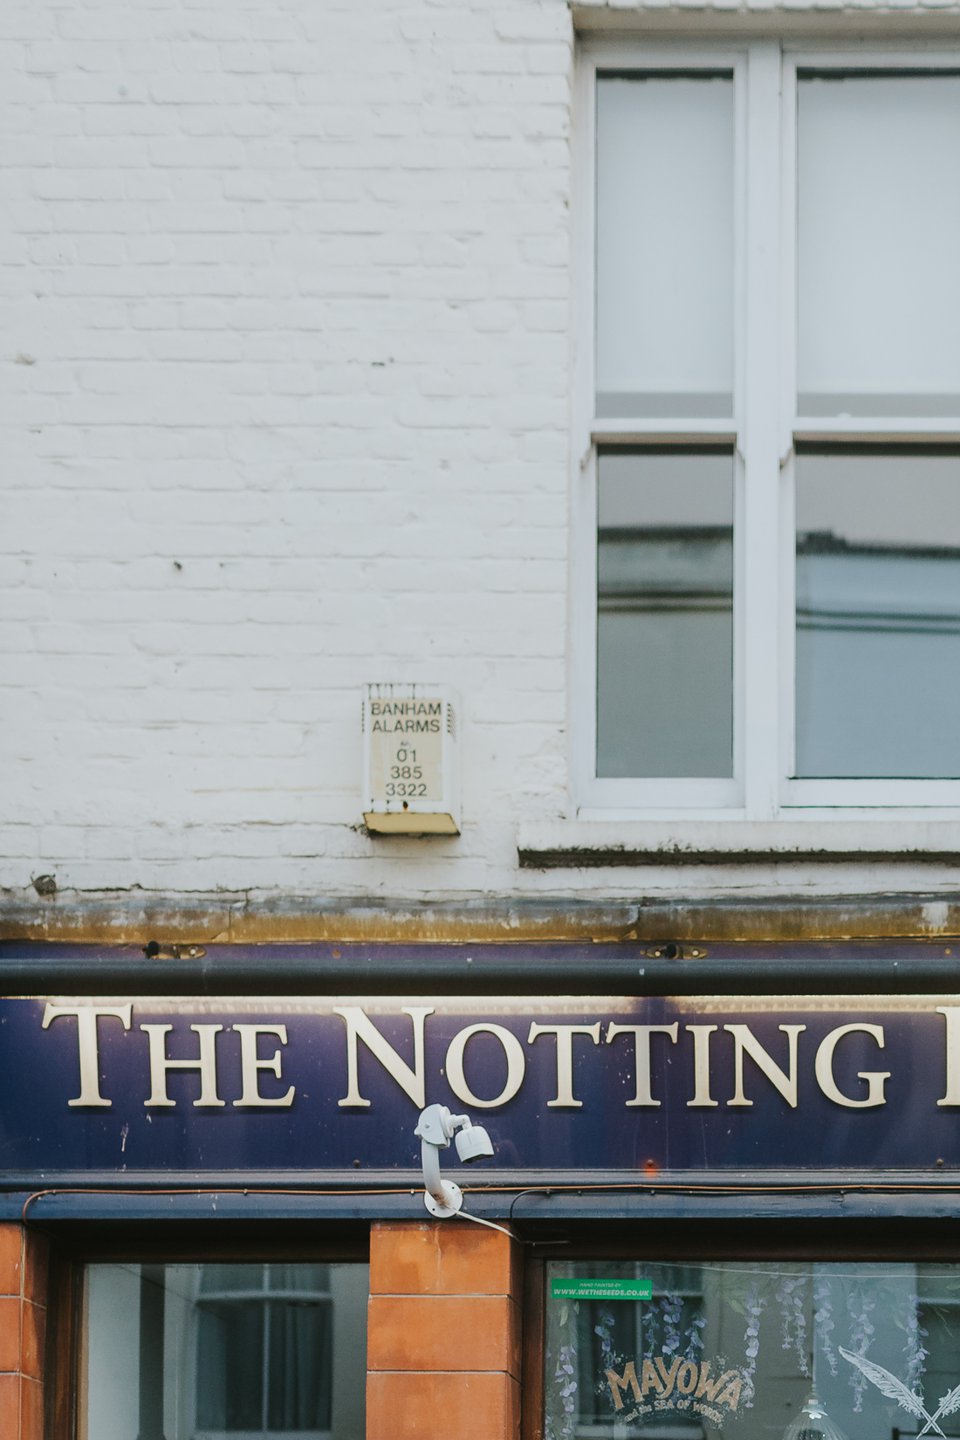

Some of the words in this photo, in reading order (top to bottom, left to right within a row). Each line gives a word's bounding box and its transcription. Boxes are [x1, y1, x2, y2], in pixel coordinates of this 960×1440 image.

[371, 702, 442, 716] BANHAM
[372, 720, 441, 733] ALARMS
[396, 749, 417, 762] 01
[390, 766, 423, 780] 385
[386, 783, 427, 797] 3322
[42, 1003, 295, 1107] THE
[334, 1006, 891, 1109] NOTTING
[604, 1356, 744, 1412] MAYOWA
[654, 1399, 675, 1410] SEA
[677, 1399, 691, 1410] OF
